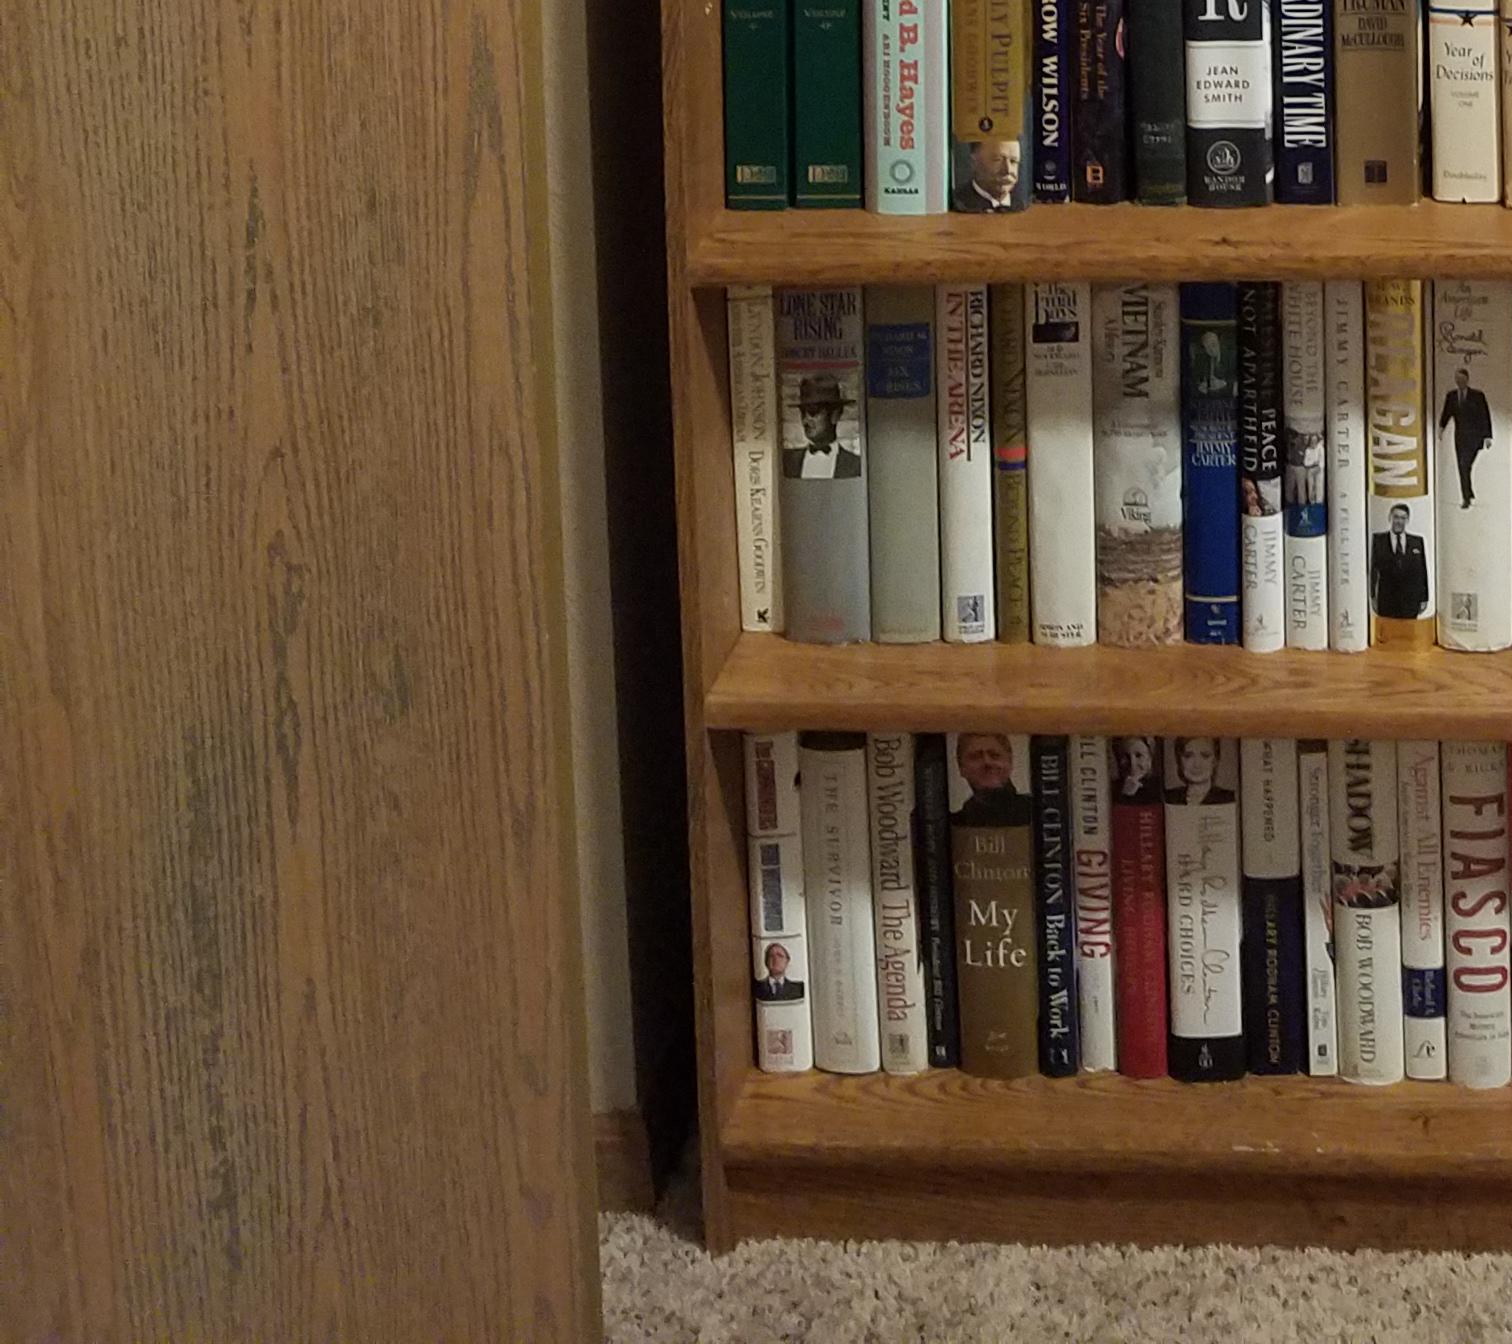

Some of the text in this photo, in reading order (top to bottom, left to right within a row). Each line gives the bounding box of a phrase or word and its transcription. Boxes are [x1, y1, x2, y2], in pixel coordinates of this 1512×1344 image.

[1196, 78, 1251, 91] EDWARD
[1203, 91, 1243, 105] SMITH
[1205, 65, 1239, 77] JEAN
[1434, 63, 1494, 82] Decisions
[898, 59, 918, 151] Hayes
[1041, 54, 1060, 148] WILSON
[1282, 92, 1327, 149] TIME
[1290, 554, 1307, 630] CARTER
[968, 900, 1018, 935] My
[1076, 850, 1110, 960] GIVING
[1448, 793, 1509, 994] FIASCO
[963, 940, 1027, 968] Life
[1178, 916, 1196, 996] CHOICES
